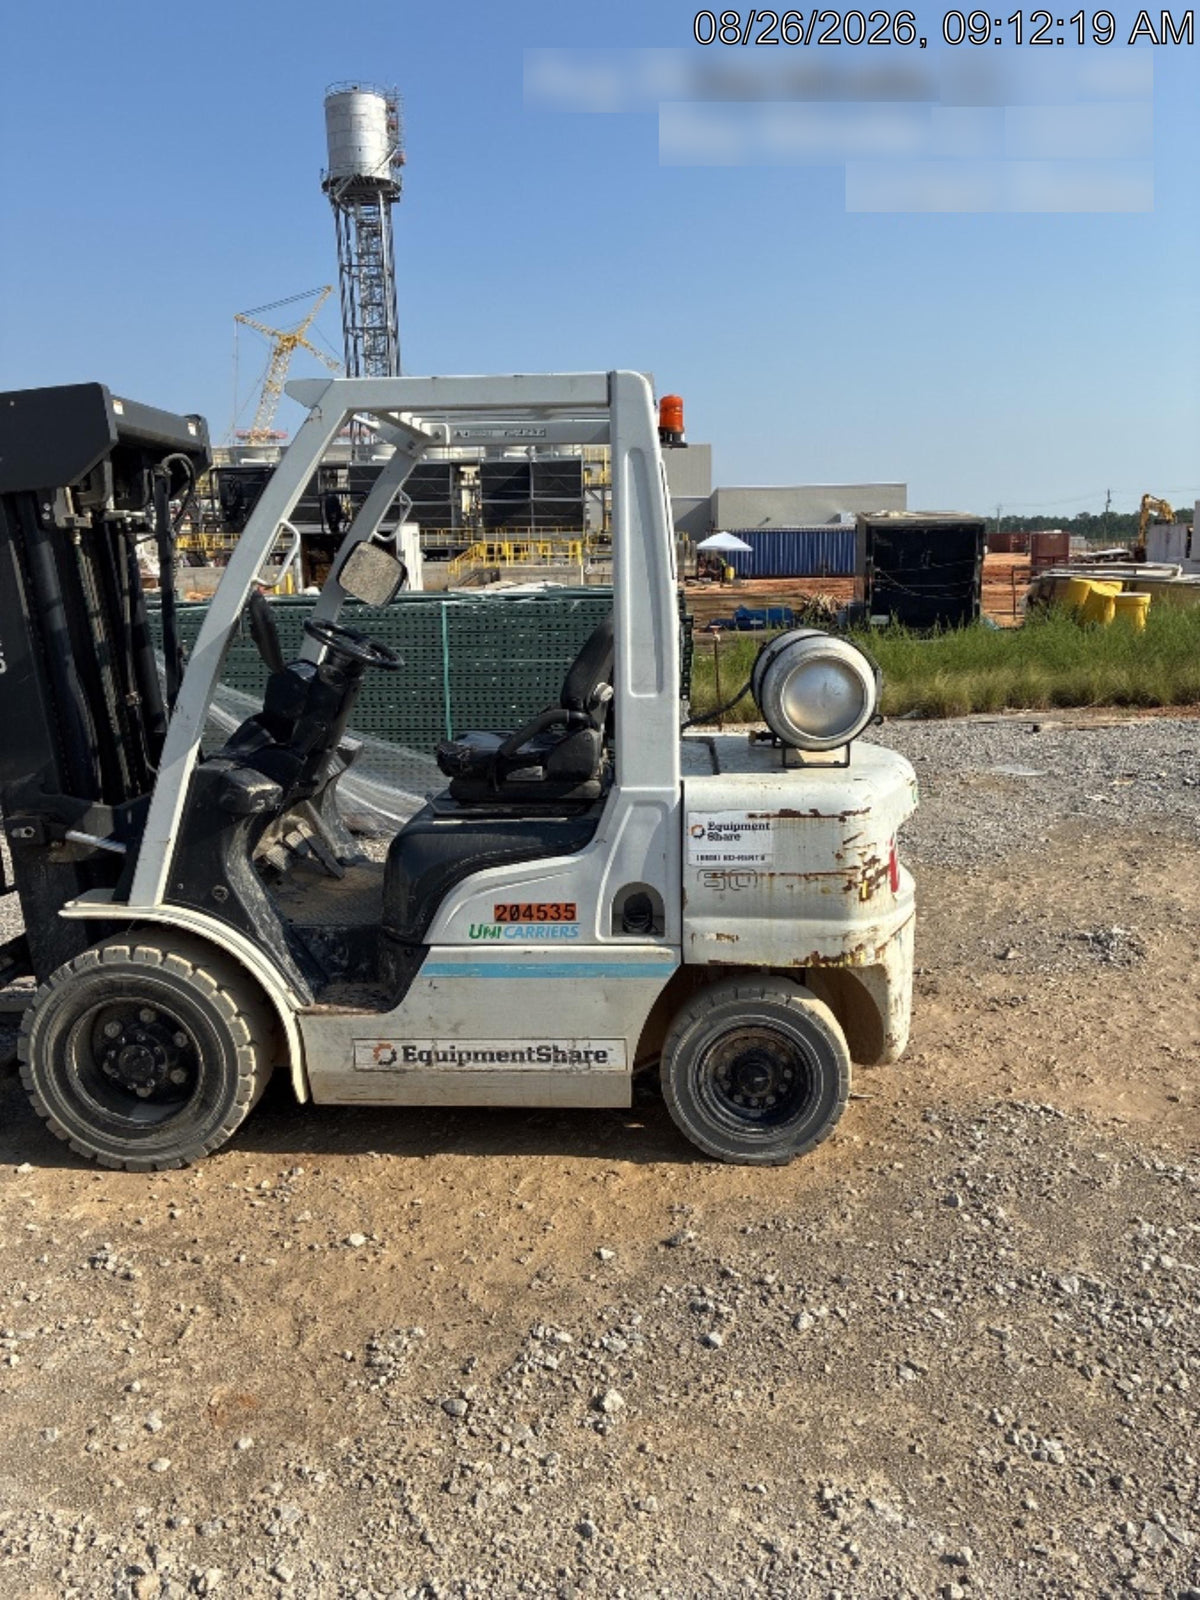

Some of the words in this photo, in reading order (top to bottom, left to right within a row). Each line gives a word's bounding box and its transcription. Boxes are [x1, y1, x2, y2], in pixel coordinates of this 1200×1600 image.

[707, 821, 770, 833] Equipment
[707, 832, 742, 841] Share
[495, 903, 577, 922] 204535
[402, 1044, 609, 1066] EquipmentShare
